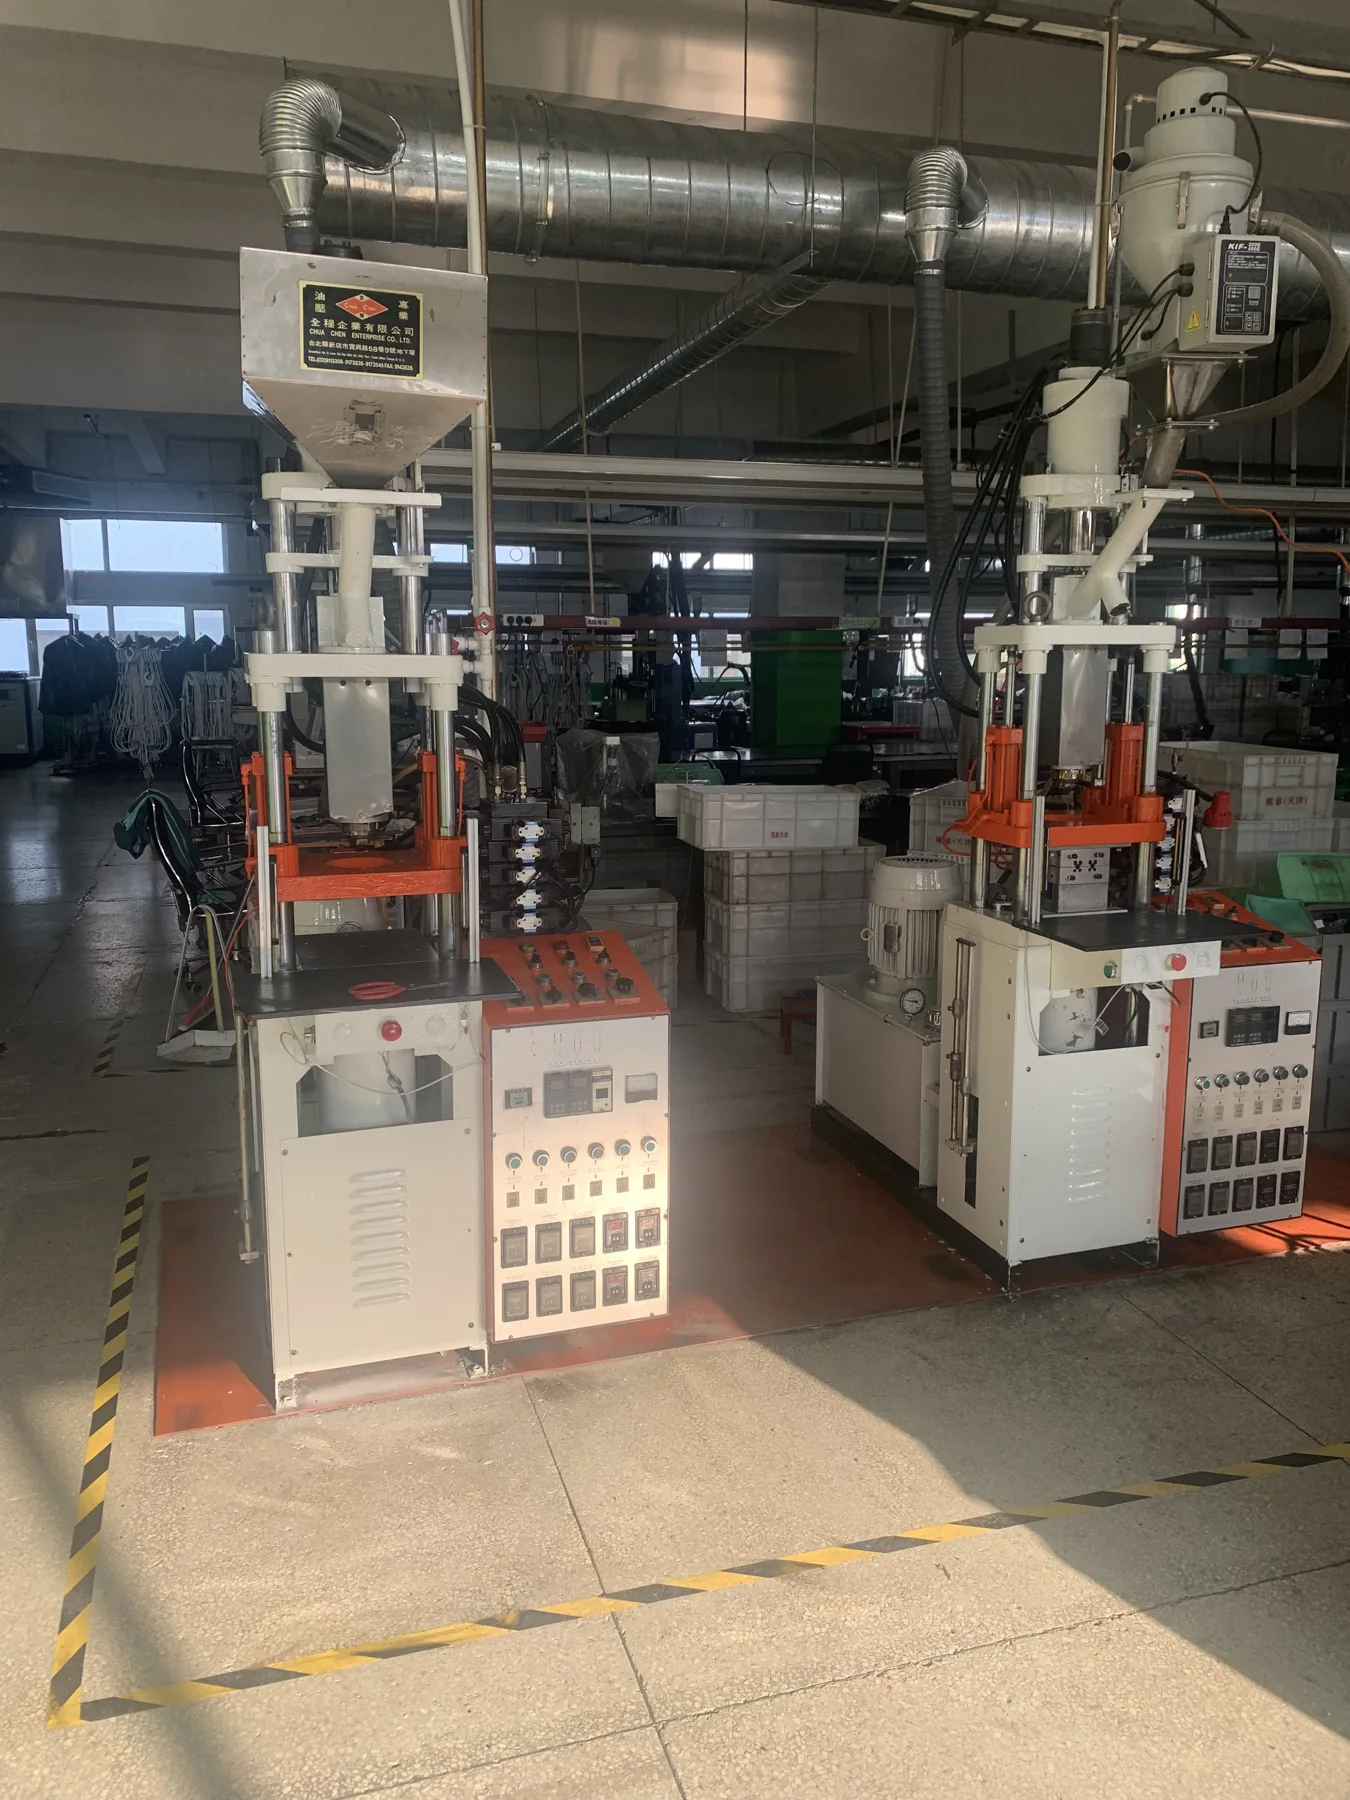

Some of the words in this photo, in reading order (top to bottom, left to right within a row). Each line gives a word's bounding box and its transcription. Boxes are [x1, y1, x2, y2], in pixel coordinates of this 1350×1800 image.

[309, 328, 325, 336] CHUA
[330, 330, 346, 338] CHEN
[352, 332, 385, 342] ENTERPRISE
[310, 317, 414, 337] 全程企業有限公司
